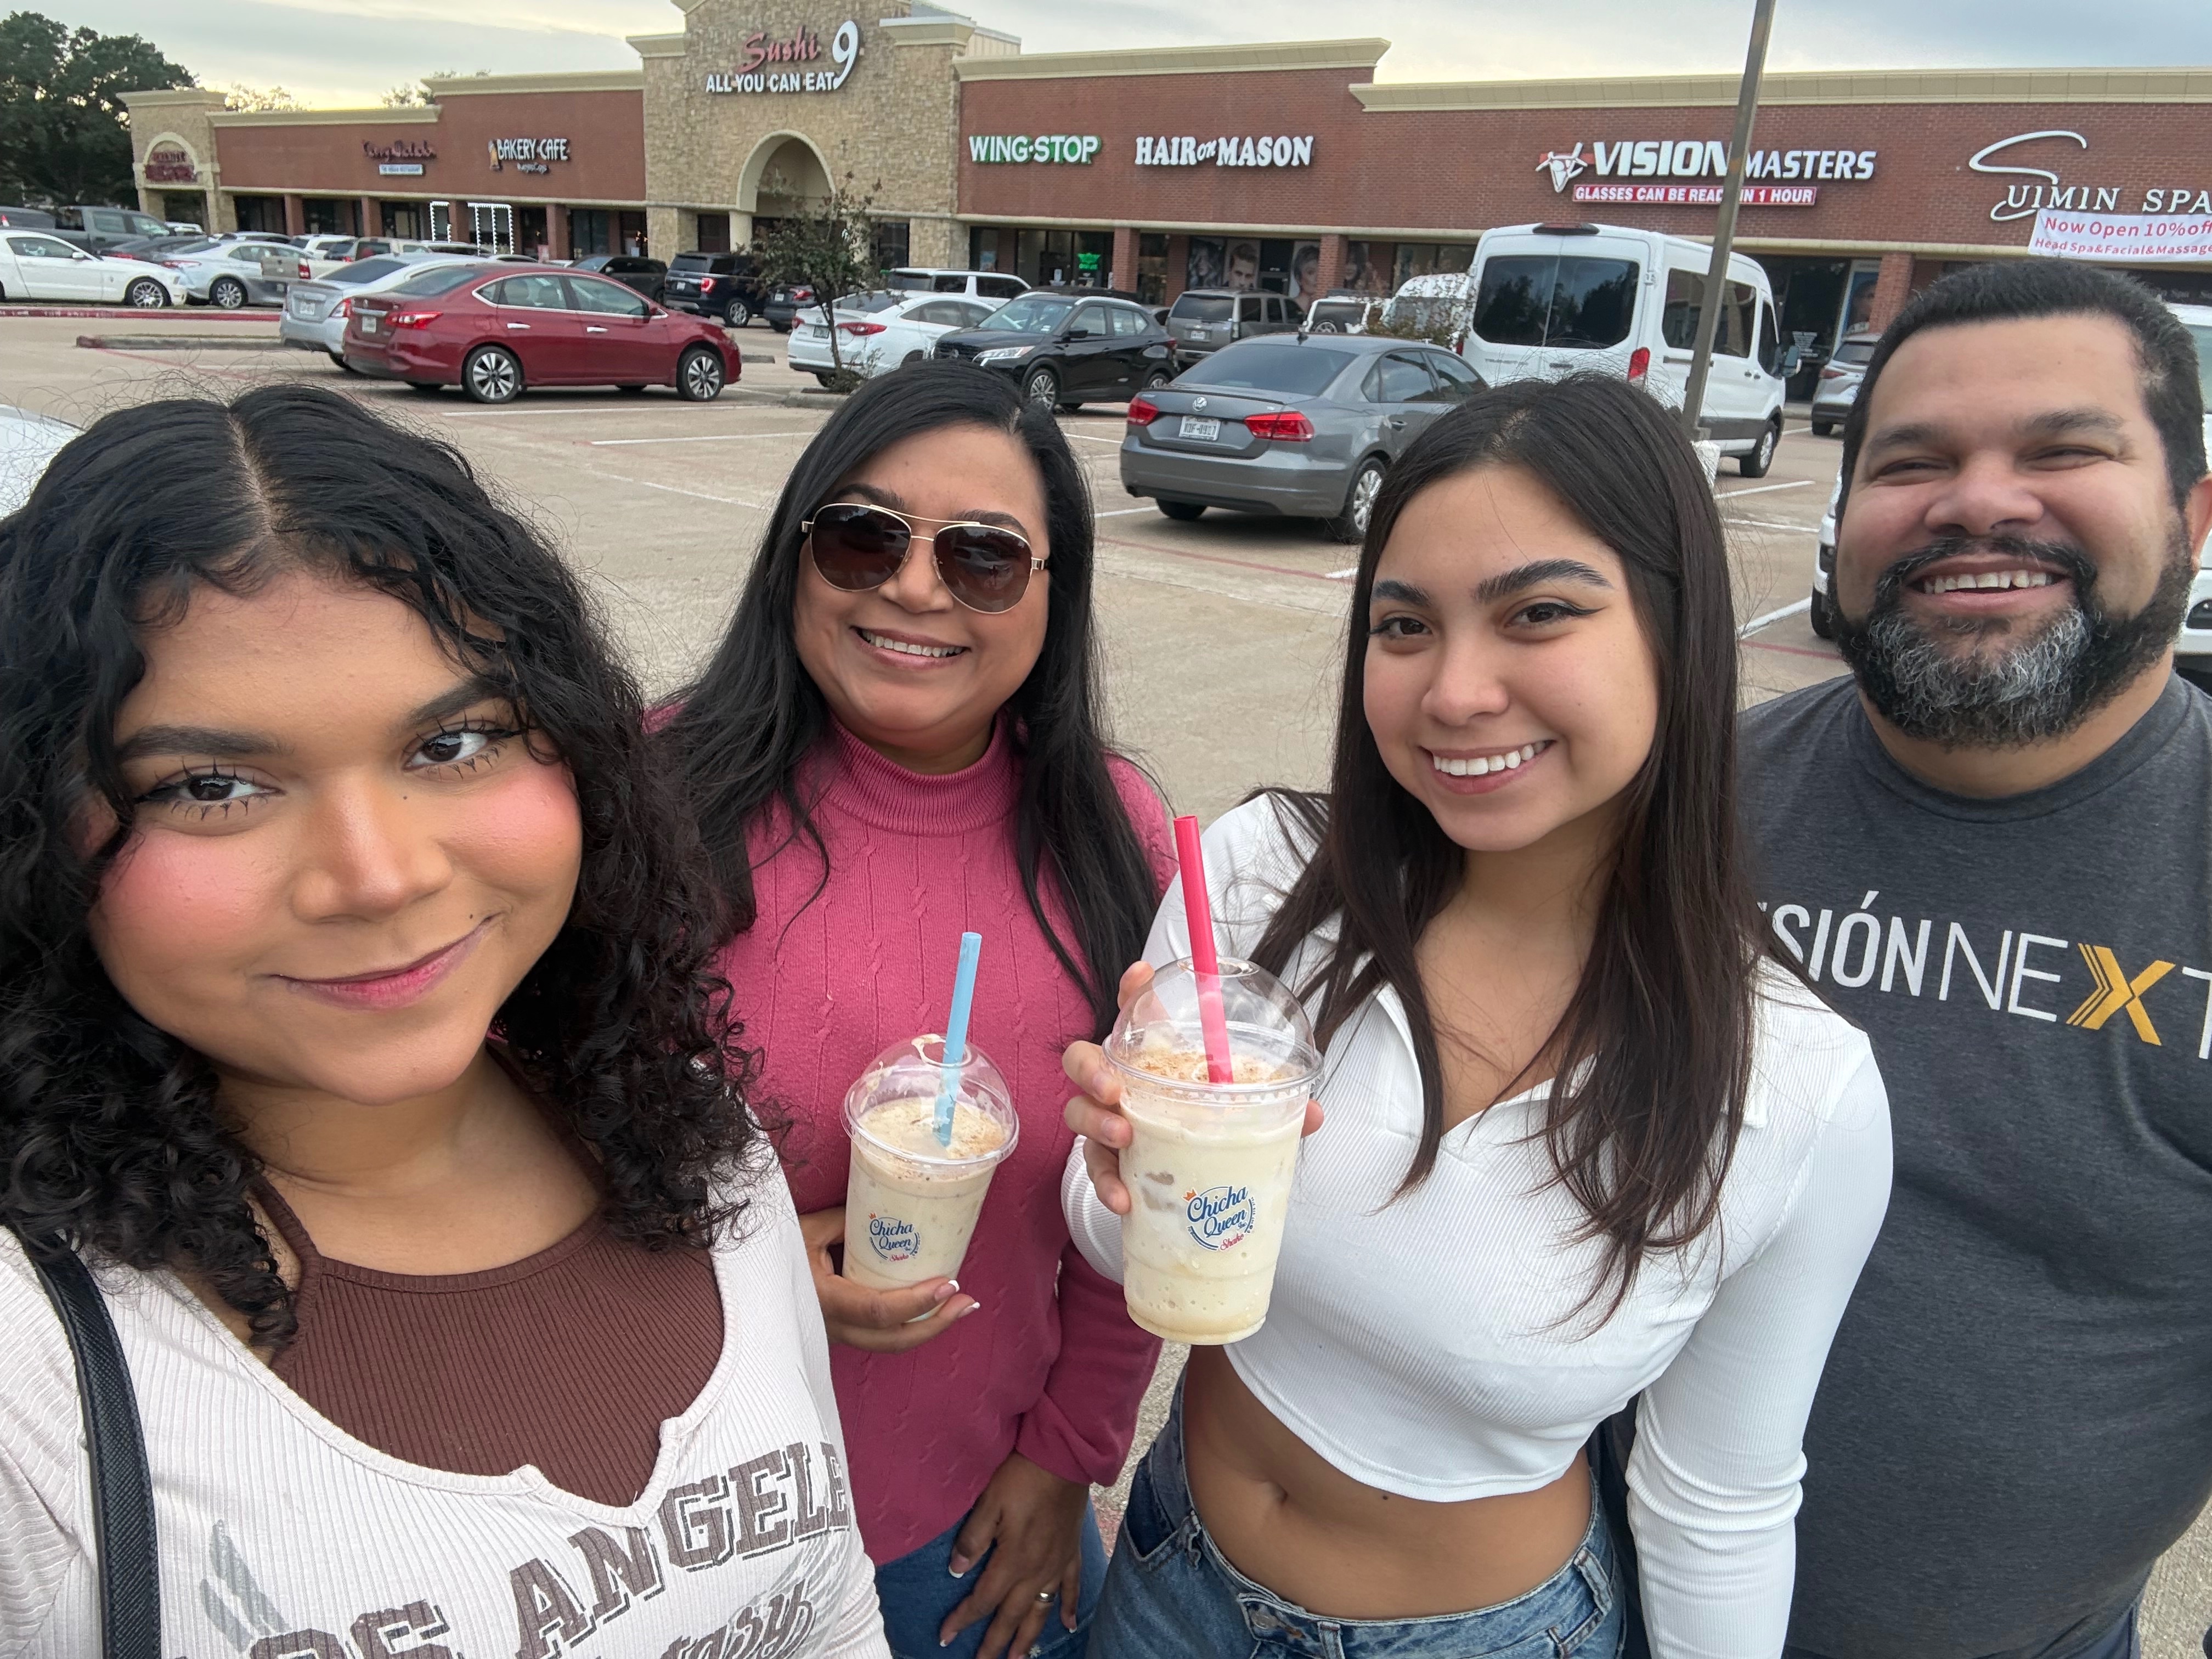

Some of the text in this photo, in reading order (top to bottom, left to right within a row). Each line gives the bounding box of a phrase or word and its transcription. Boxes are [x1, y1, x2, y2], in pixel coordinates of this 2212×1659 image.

[736, 20, 859, 89] Sushi 9
[706, 72, 835, 92] ALL YOU CAN EAT
[496, 138, 568, 161] BAKERY CAFE
[1135, 136, 1314, 166] HAIR on MASON
[1593, 140, 1877, 180] VISION MASTERS
[1576, 187, 1633, 201] GLASSES
[1637, 188, 1664, 202] CAN
[1668, 188, 1686, 202] BE
[1739, 188, 1755, 202] IN
[1758, 188, 1766, 202] 1
[1770, 188, 1813, 203] HOUR
[2142, 188, 2212, 215] SPA
[2045, 216, 2085, 234] Now
[2089, 221, 2139, 239] Open
[2035, 238, 2068, 251] Head
[1757, 890, 1932, 997] SIÓN
[1187, 1186, 1249, 1222] Chicha
[870, 1218, 914, 1236] Chicha
[1204, 1210, 1247, 1238] Queen
[879, 1235, 912, 1250] Queen
